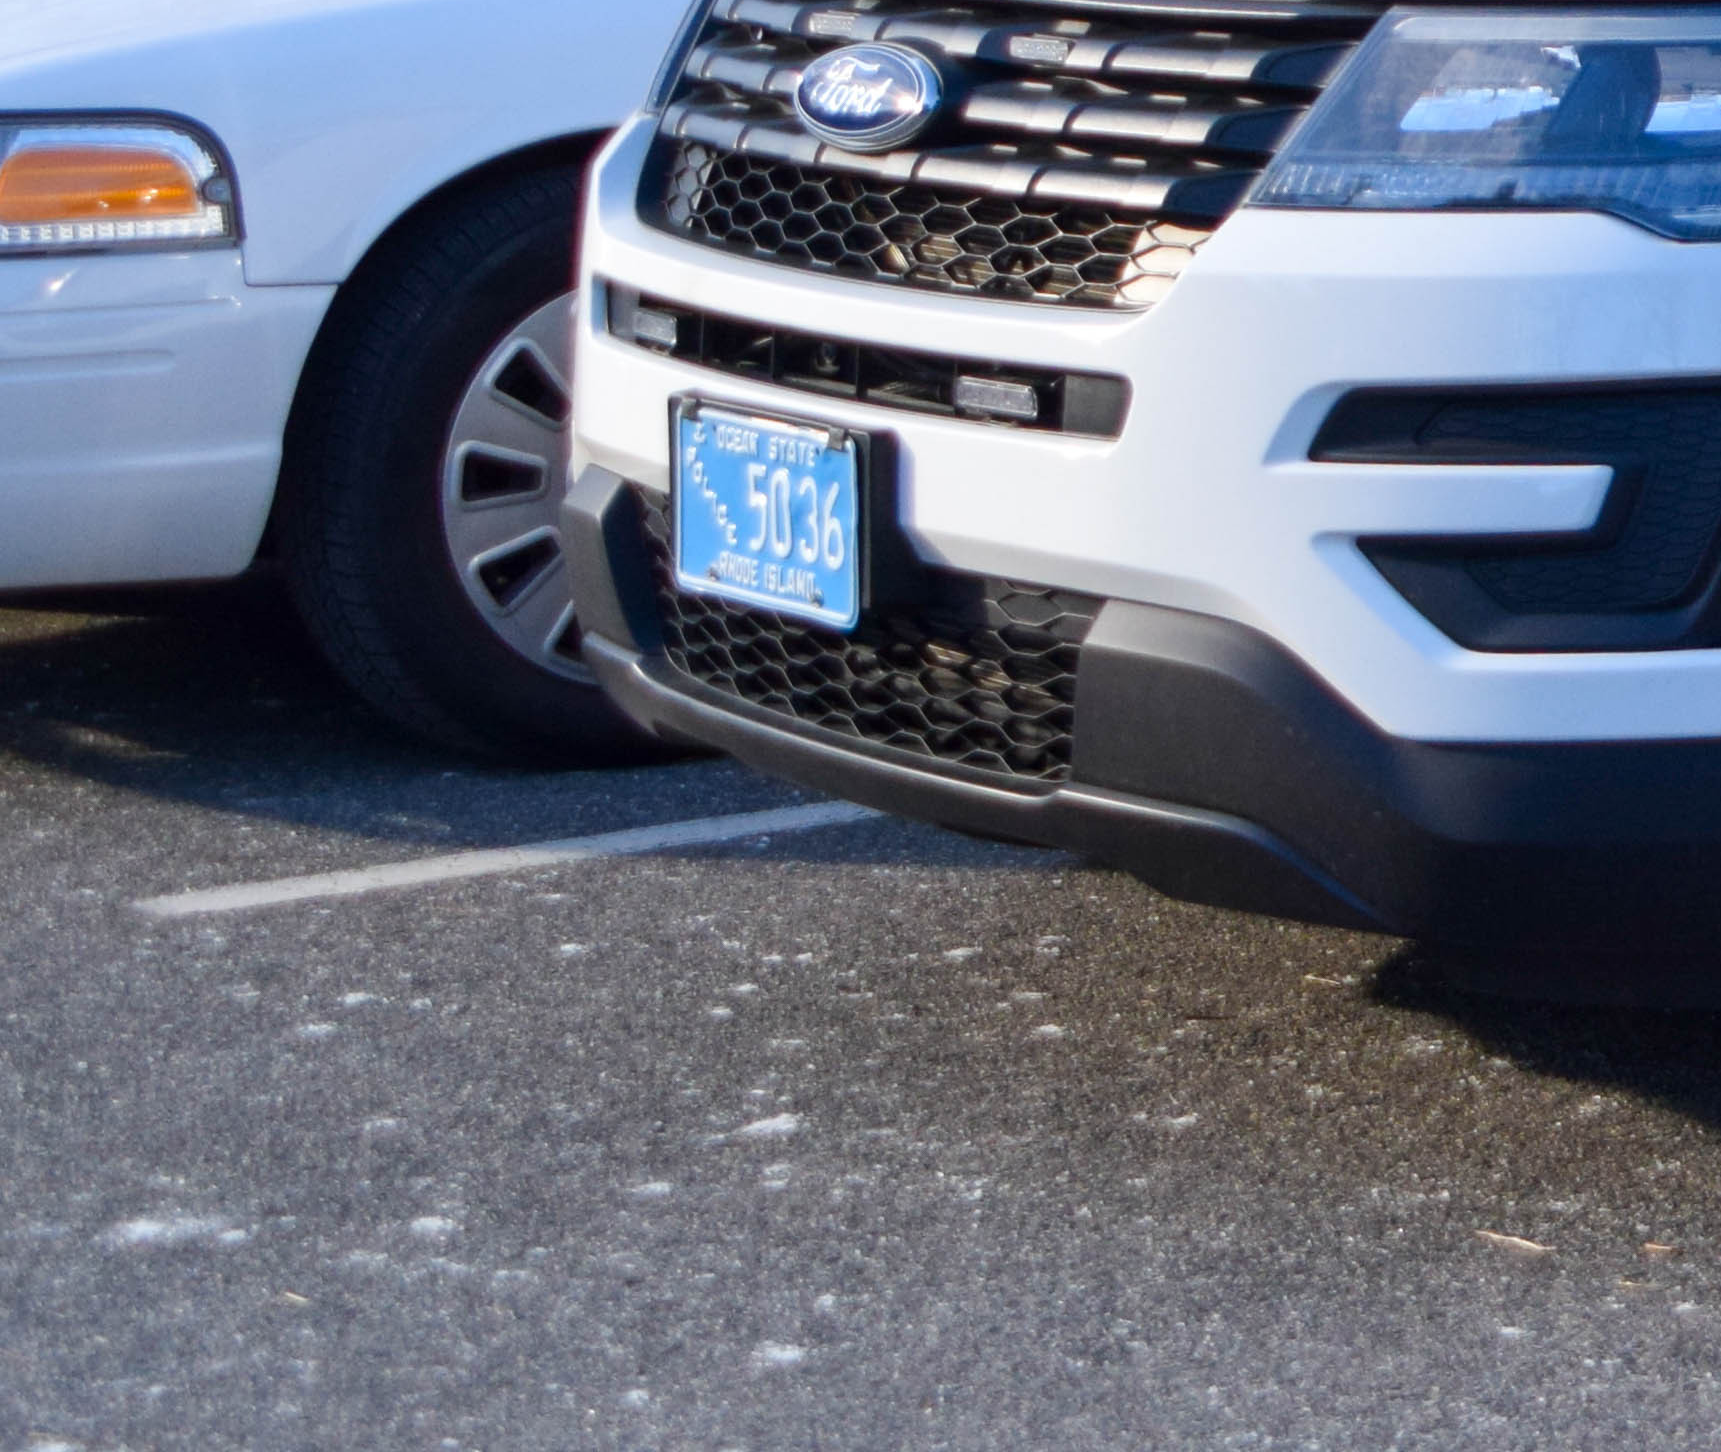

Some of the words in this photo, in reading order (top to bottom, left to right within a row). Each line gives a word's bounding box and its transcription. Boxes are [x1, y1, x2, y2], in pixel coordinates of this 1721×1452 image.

[811, 56, 894, 118] Ford
[716, 425, 759, 456] OCEAN
[768, 435, 817, 467] STATE
[747, 462, 846, 571] 5036
[718, 550, 760, 588] RHODE
[763, 562, 817, 601] ISLAND
